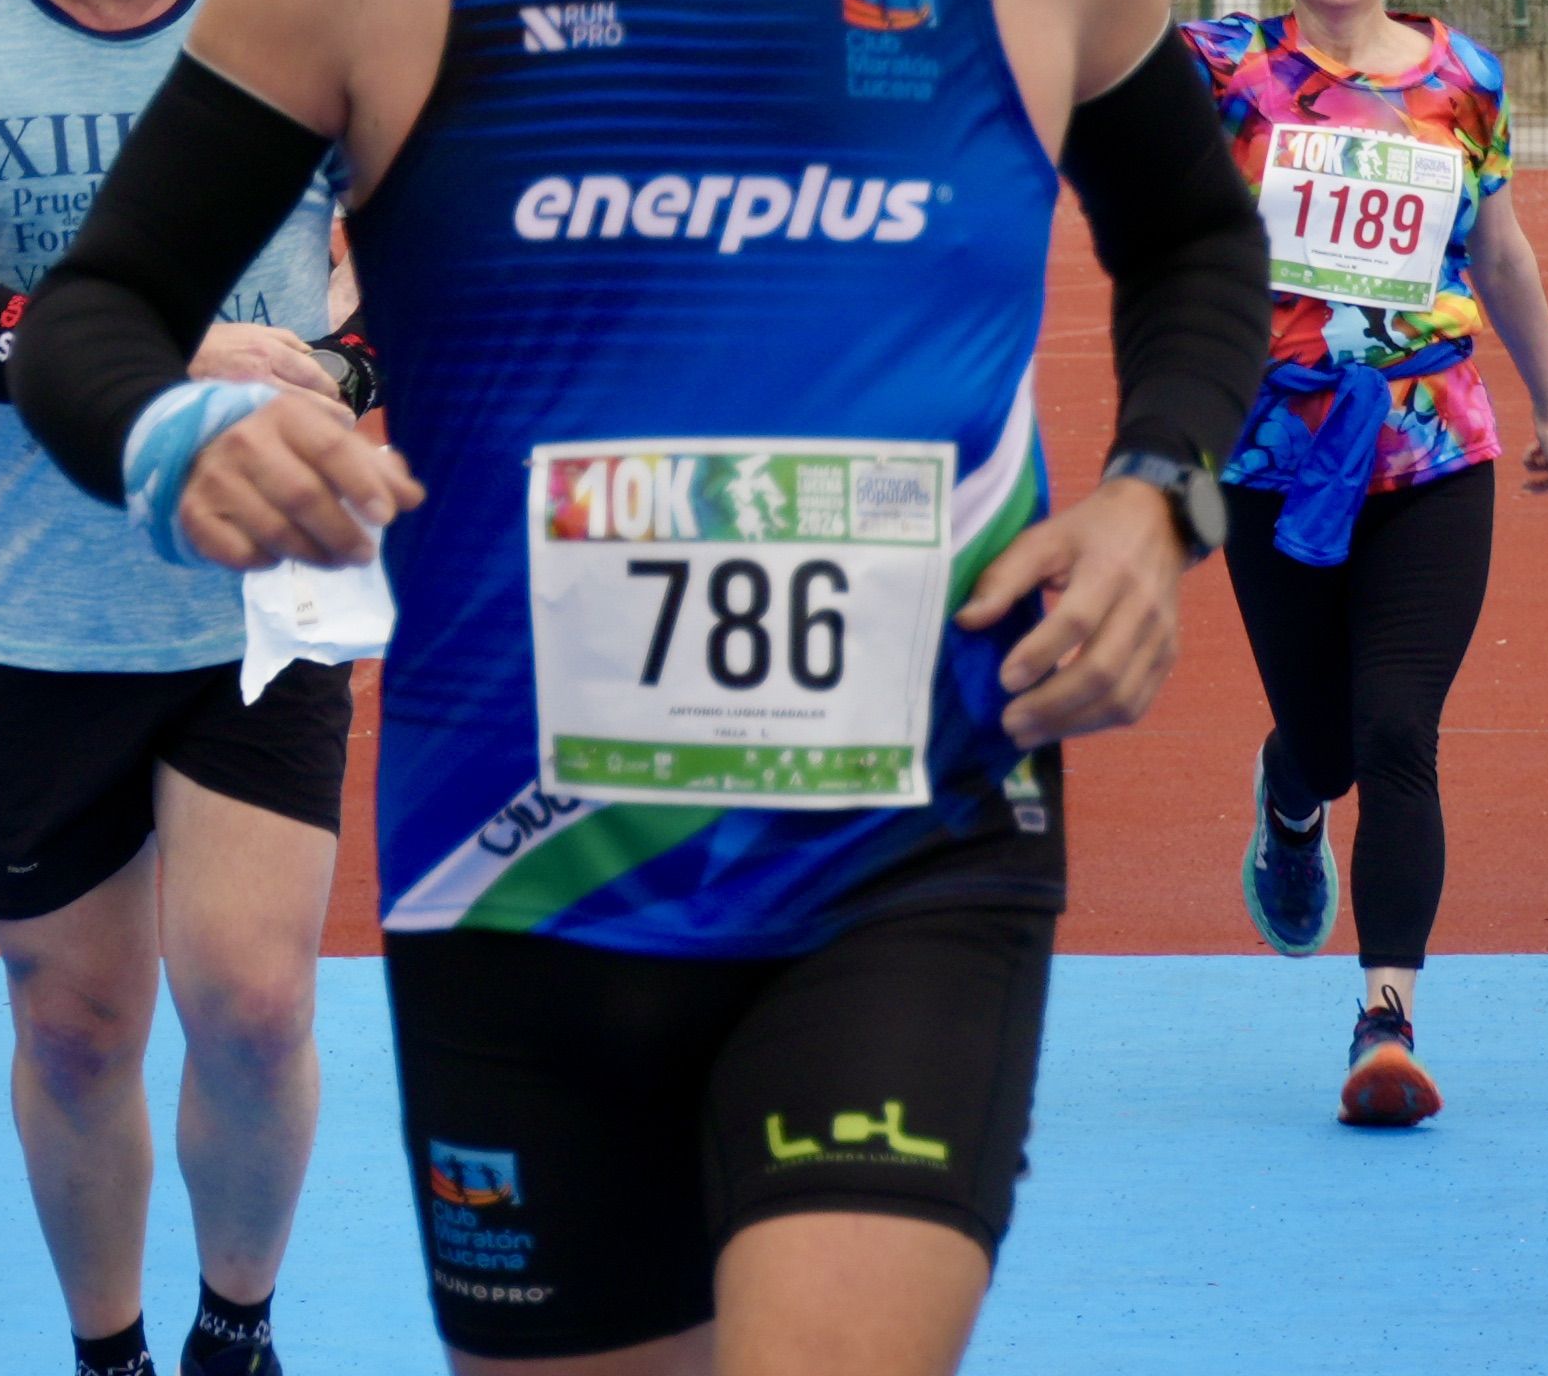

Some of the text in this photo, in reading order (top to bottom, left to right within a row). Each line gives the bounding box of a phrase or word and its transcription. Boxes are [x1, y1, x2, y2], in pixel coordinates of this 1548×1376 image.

[564, 2, 615, 26] RUN
[571, 23, 624, 49] PRO
[1289, 131, 1348, 175] 10K
[513, 165, 931, 254] enerplus
[1292, 179, 1425, 256] 1189
[575, 458, 700, 540] 10K
[626, 559, 849, 690] 786
[437, 1243, 526, 1269] Lucena
